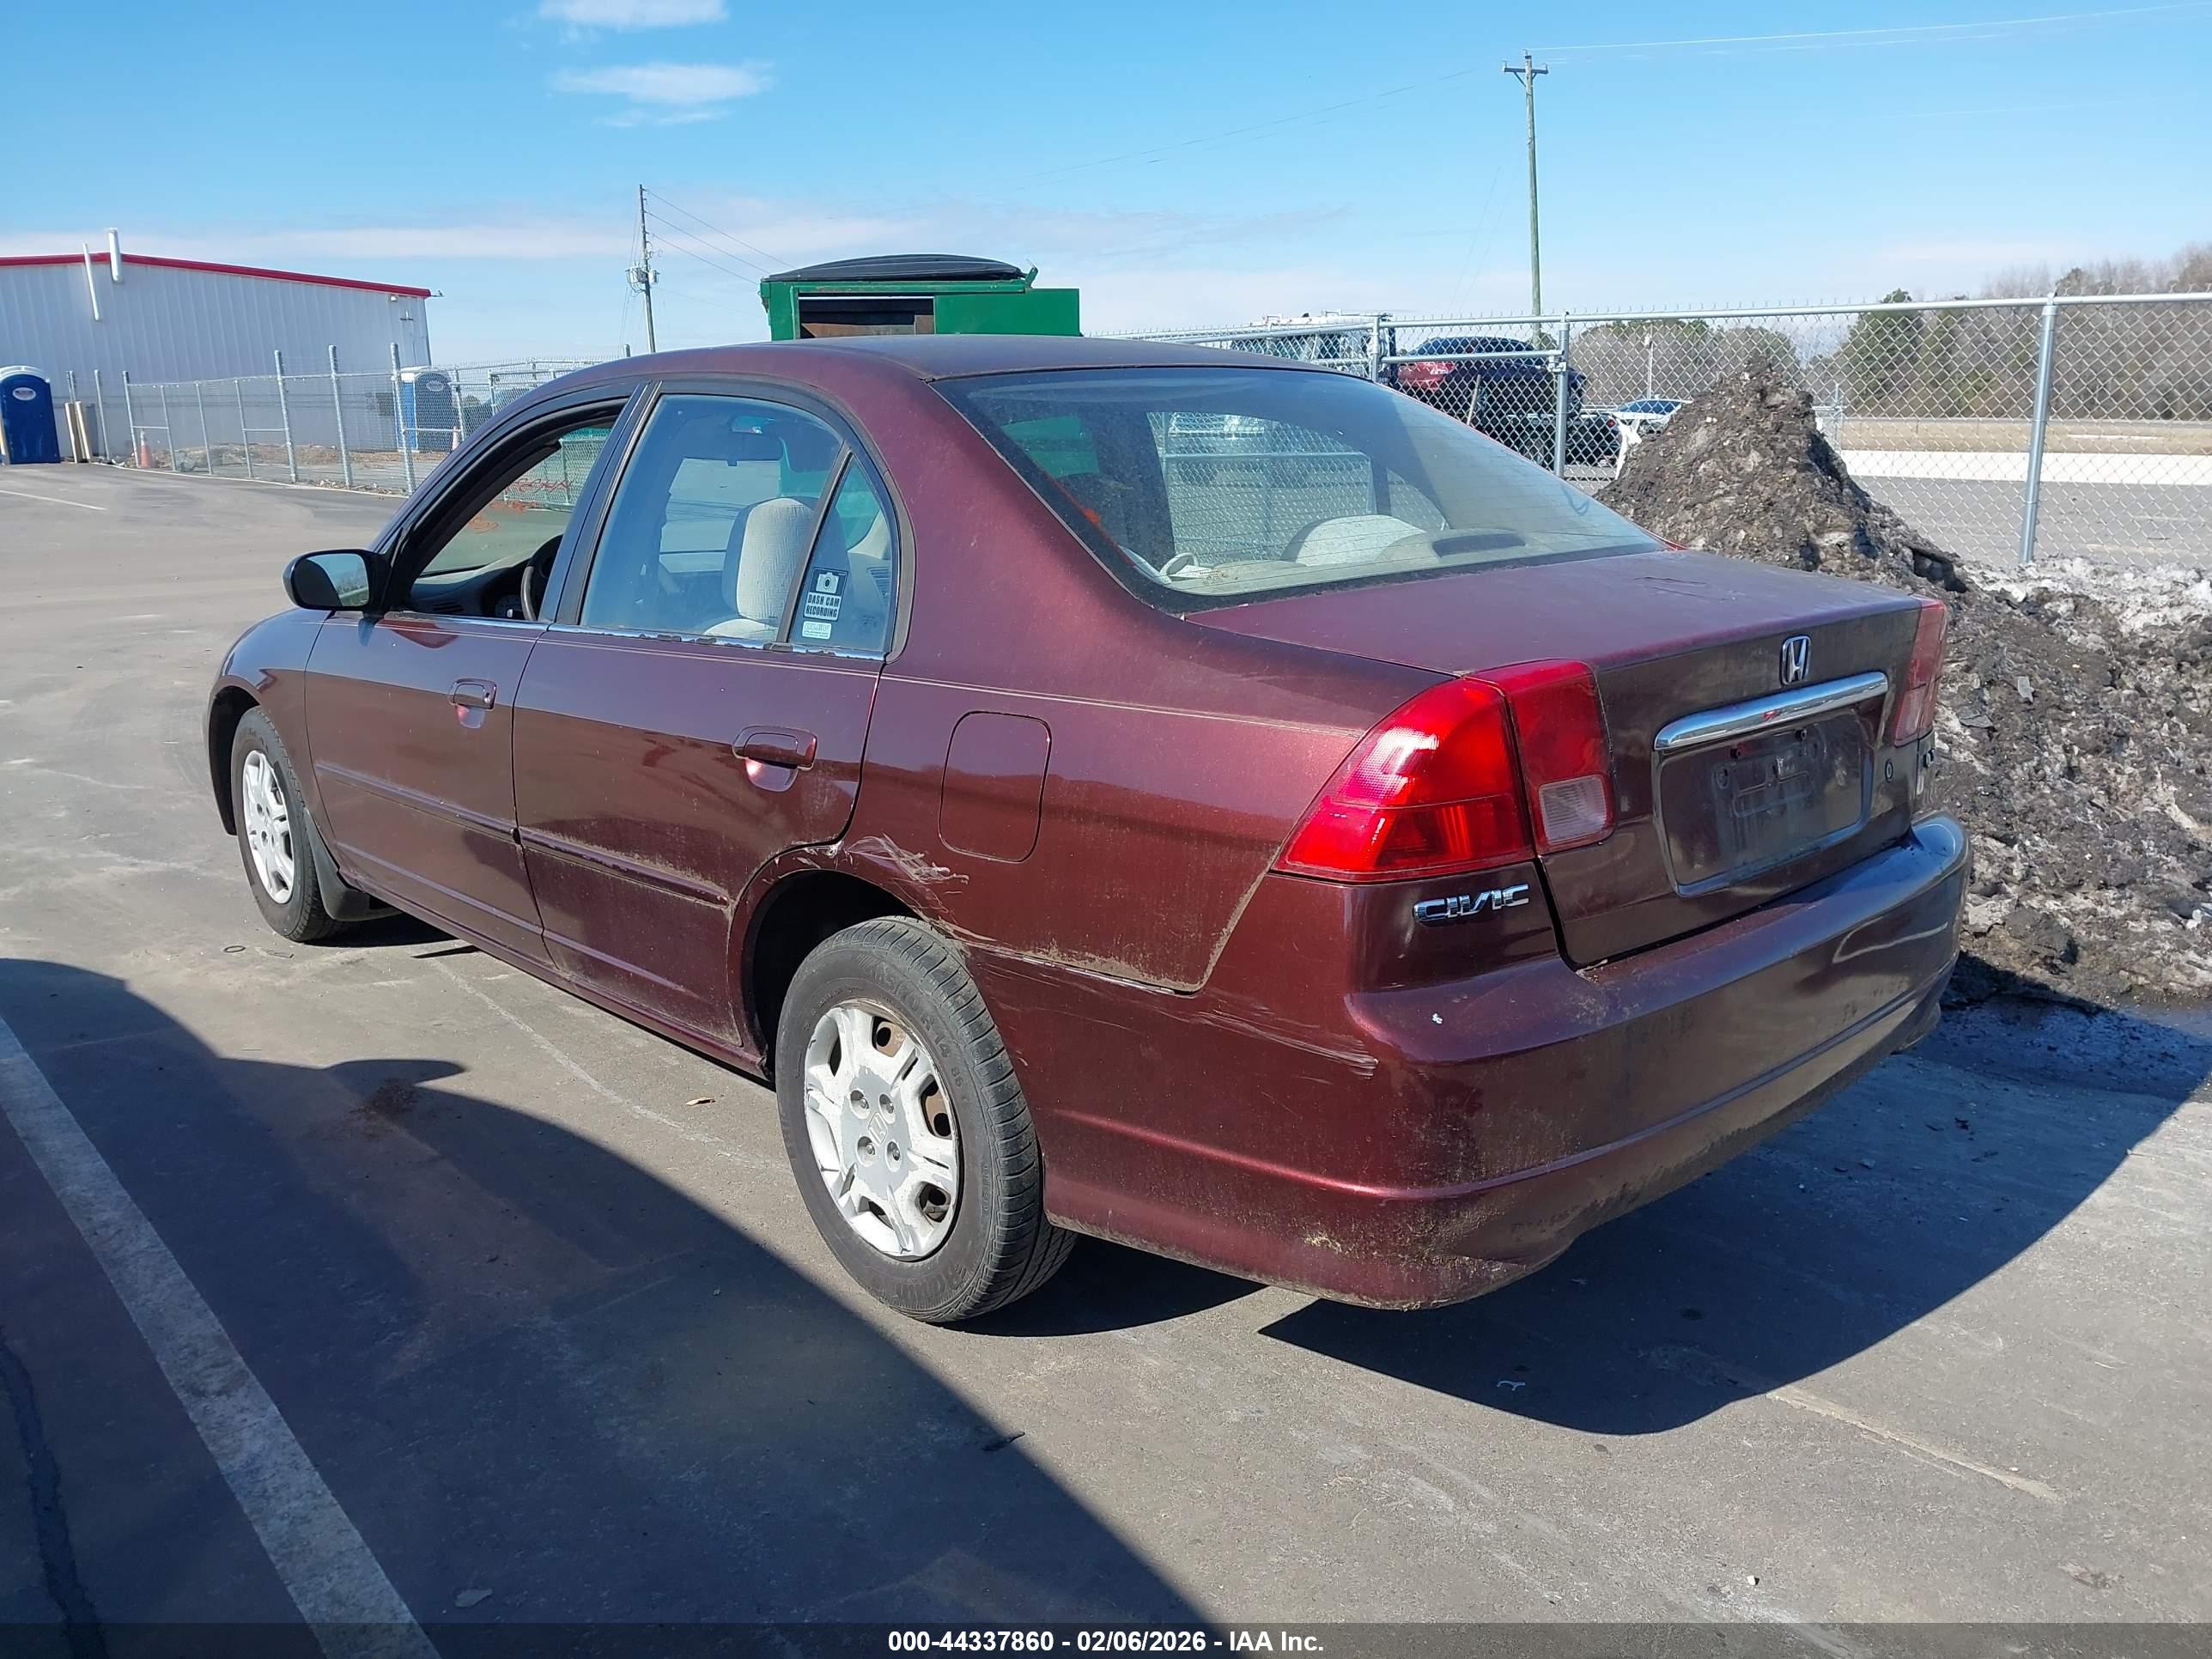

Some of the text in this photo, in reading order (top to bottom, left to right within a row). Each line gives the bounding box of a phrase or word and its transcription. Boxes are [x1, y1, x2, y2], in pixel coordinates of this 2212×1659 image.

[807, 594, 840, 607] DASH CAM
[805, 605, 837, 617] RECORDING
[1413, 883, 1530, 922] CIVIC
